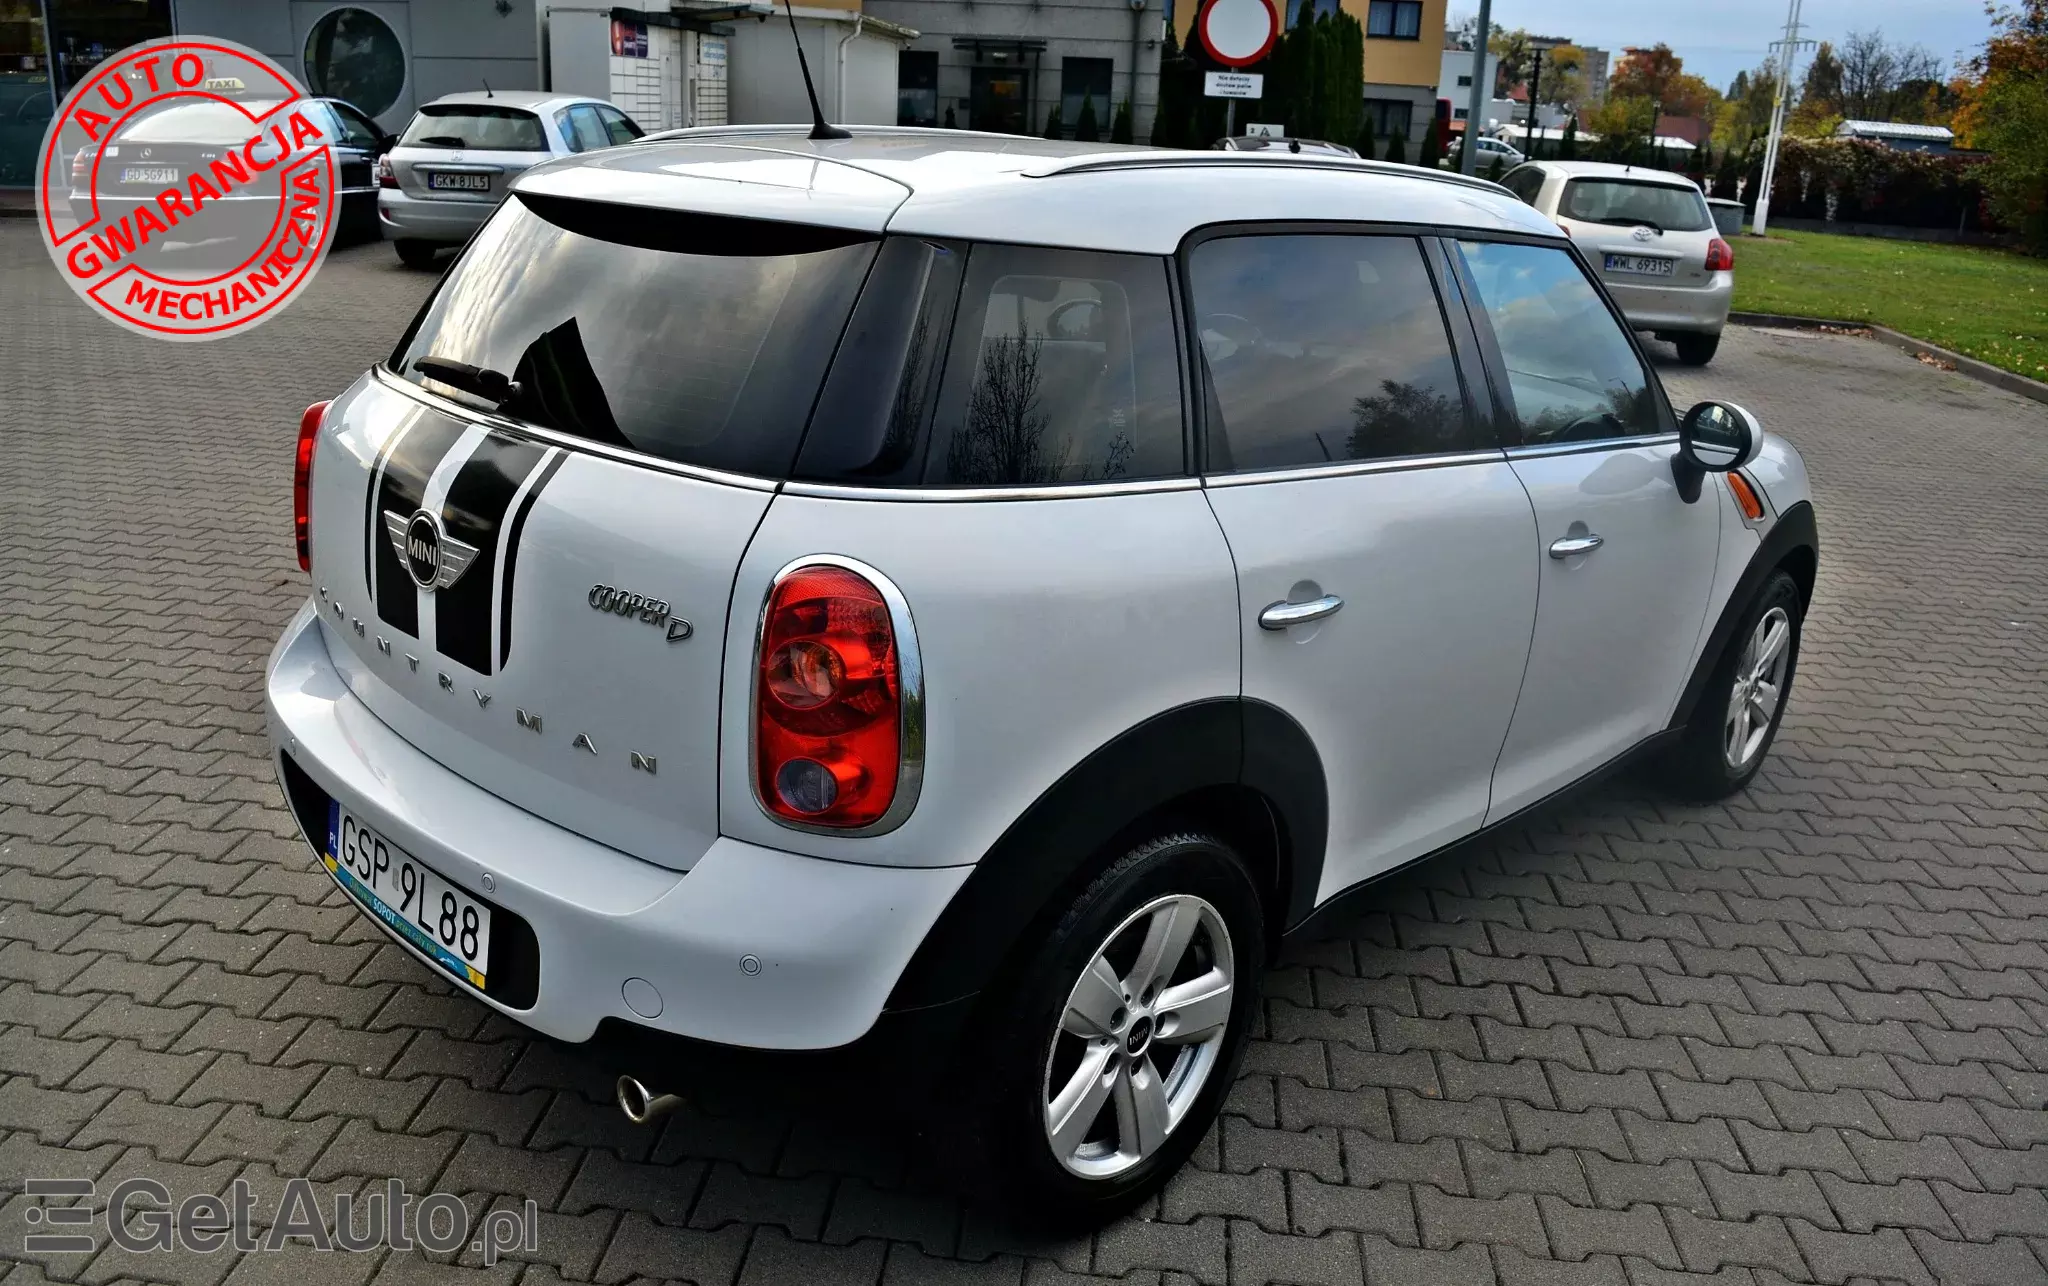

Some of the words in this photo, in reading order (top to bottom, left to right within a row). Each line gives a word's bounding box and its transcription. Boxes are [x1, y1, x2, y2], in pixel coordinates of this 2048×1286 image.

[207, 80, 236, 89] TAXI
[127, 169, 141, 181] GD
[144, 170, 178, 182] 5G911
[435, 174, 456, 187] GKW
[459, 175, 486, 188] 8JL5
[1613, 255, 1633, 270] WWL
[408, 535, 437, 566] MINI
[587, 583, 671, 628] COOPER
[665, 615, 693, 643] D
[319, 585, 657, 775] COUNTRYMAN
[329, 831, 338, 849] PL
[342, 814, 390, 890] GSP
[400, 862, 480, 962] 9L88
[373, 898, 397, 925] SOPOT
